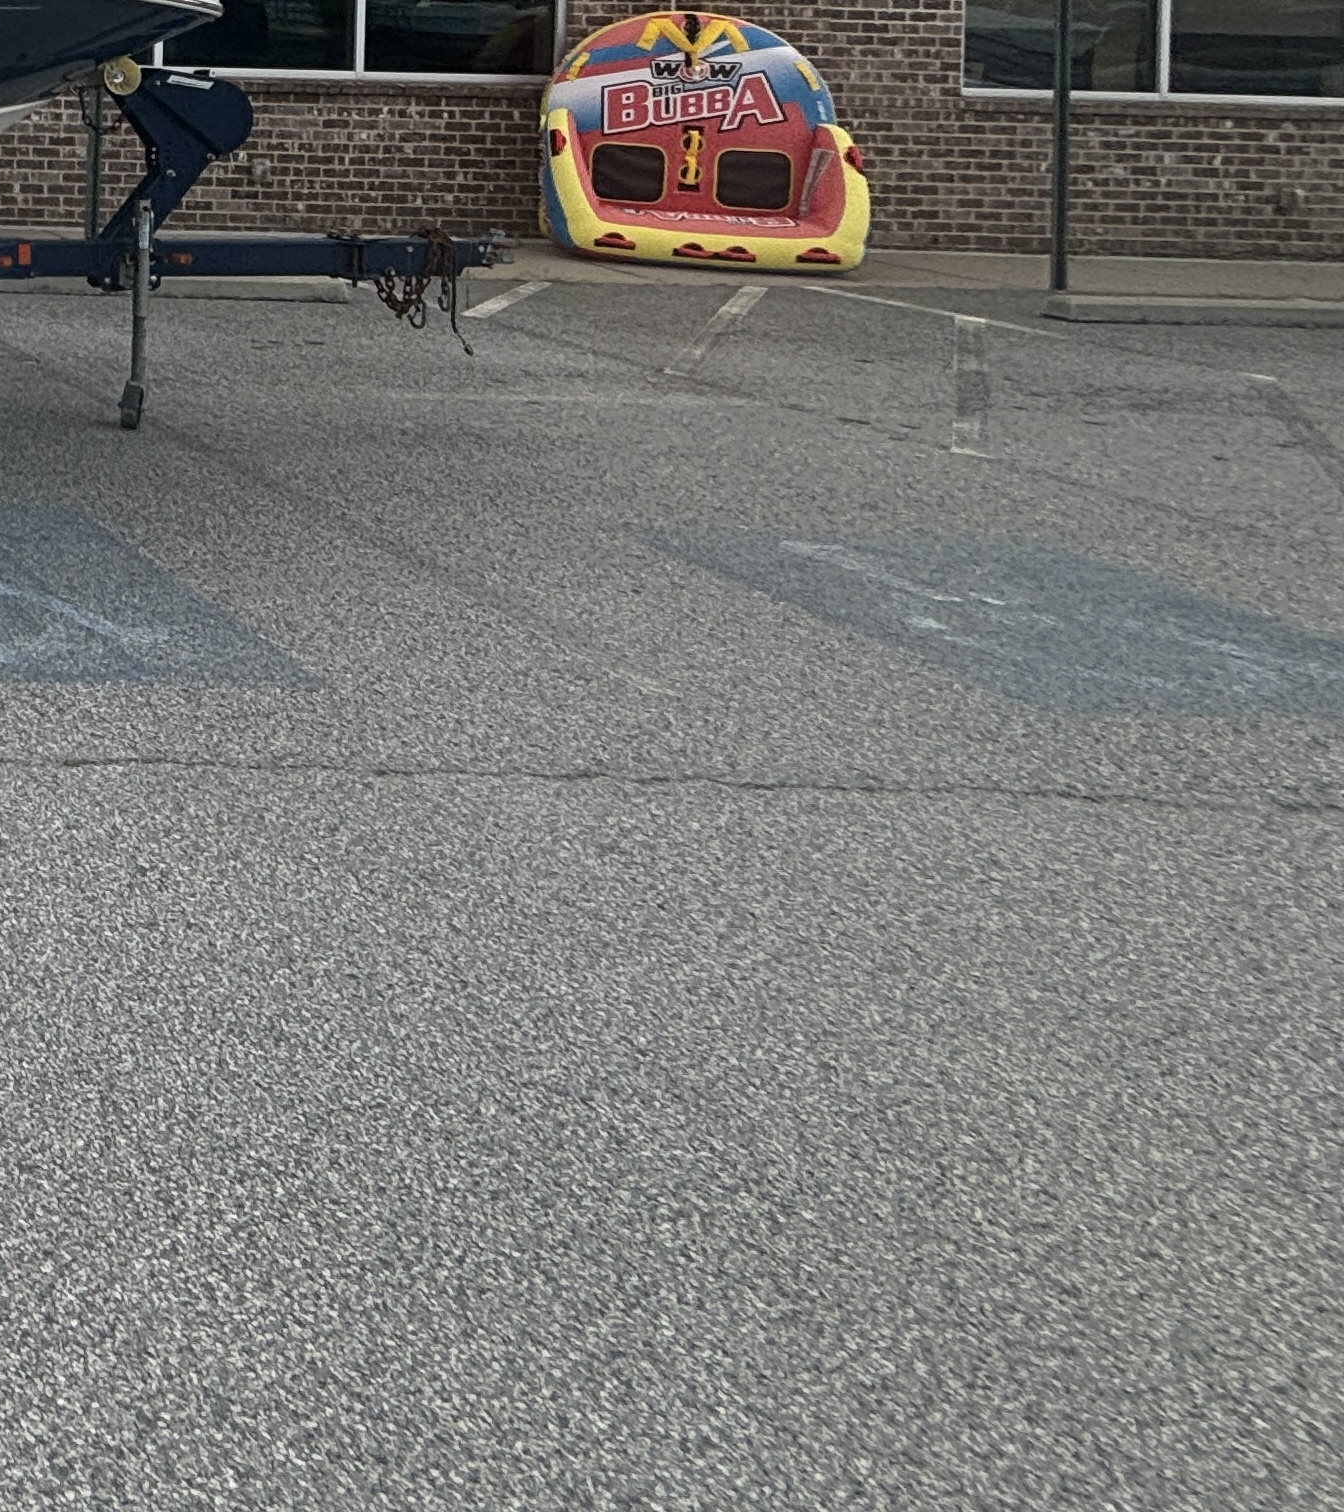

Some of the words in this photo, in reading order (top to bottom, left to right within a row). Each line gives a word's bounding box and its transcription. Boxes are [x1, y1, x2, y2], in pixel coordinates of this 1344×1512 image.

[651, 60, 742, 83] WOW
[653, 83, 683, 98] BIG
[602, 72, 786, 135] BUBBA
